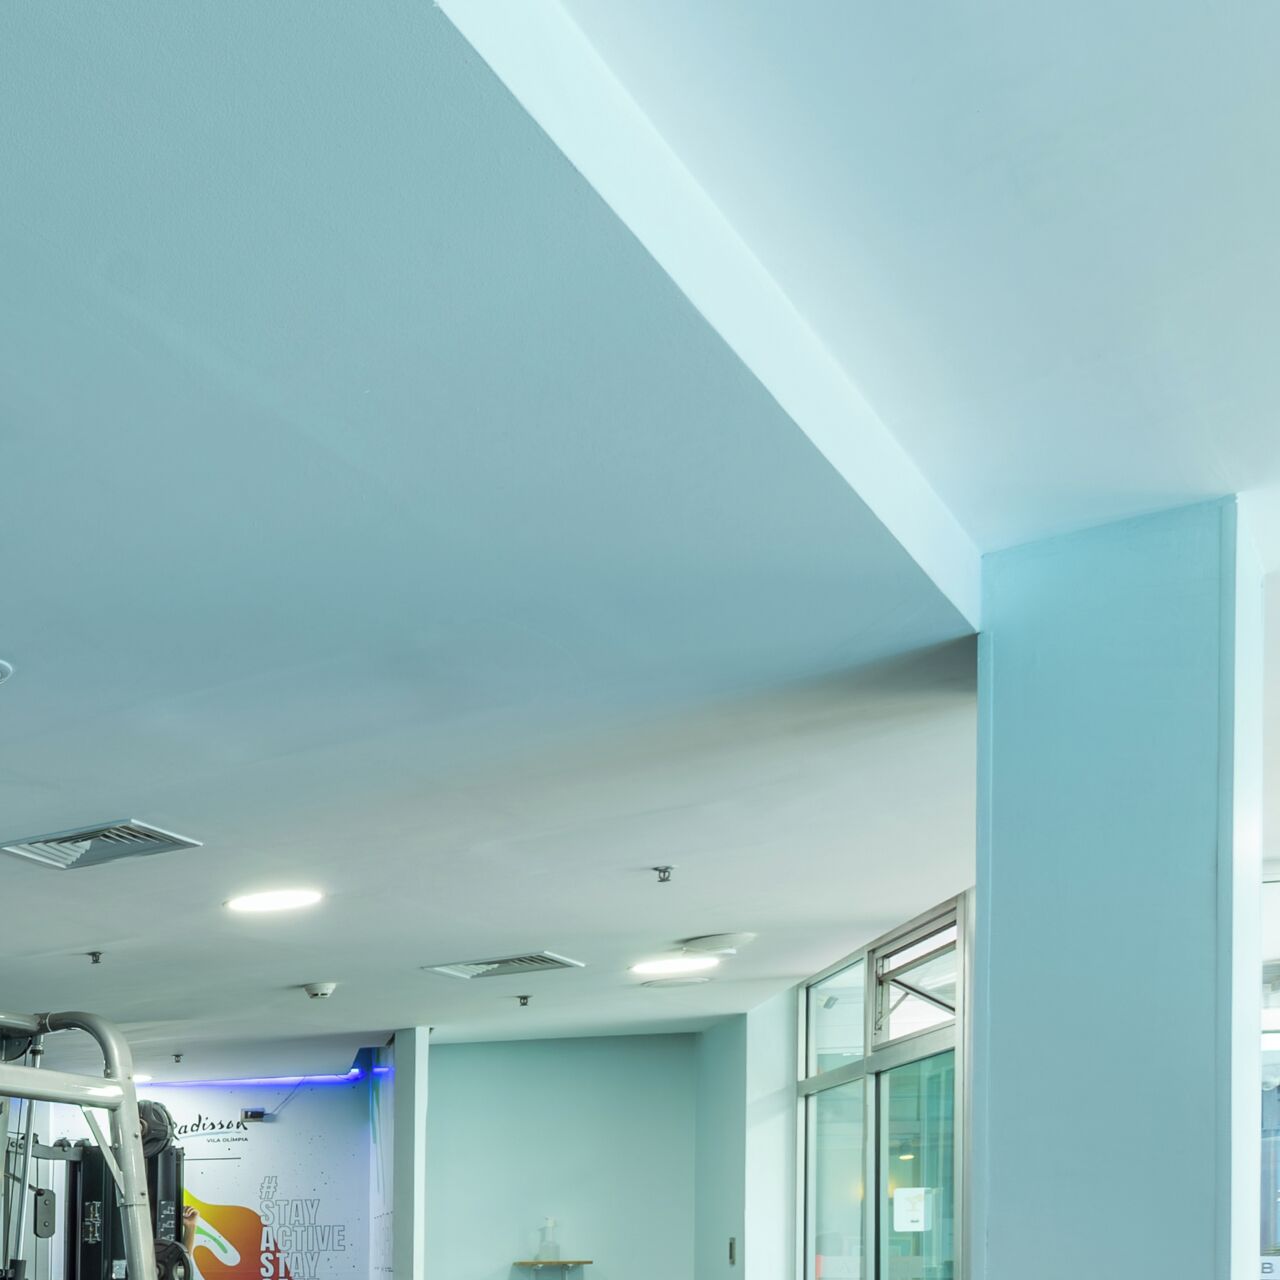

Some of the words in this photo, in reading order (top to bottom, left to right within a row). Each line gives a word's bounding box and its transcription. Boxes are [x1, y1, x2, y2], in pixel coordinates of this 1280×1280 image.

[260, 1199, 320, 1226] STAY
[260, 1225, 346, 1252] ACTIVE
[260, 1252, 320, 1278] STAY
